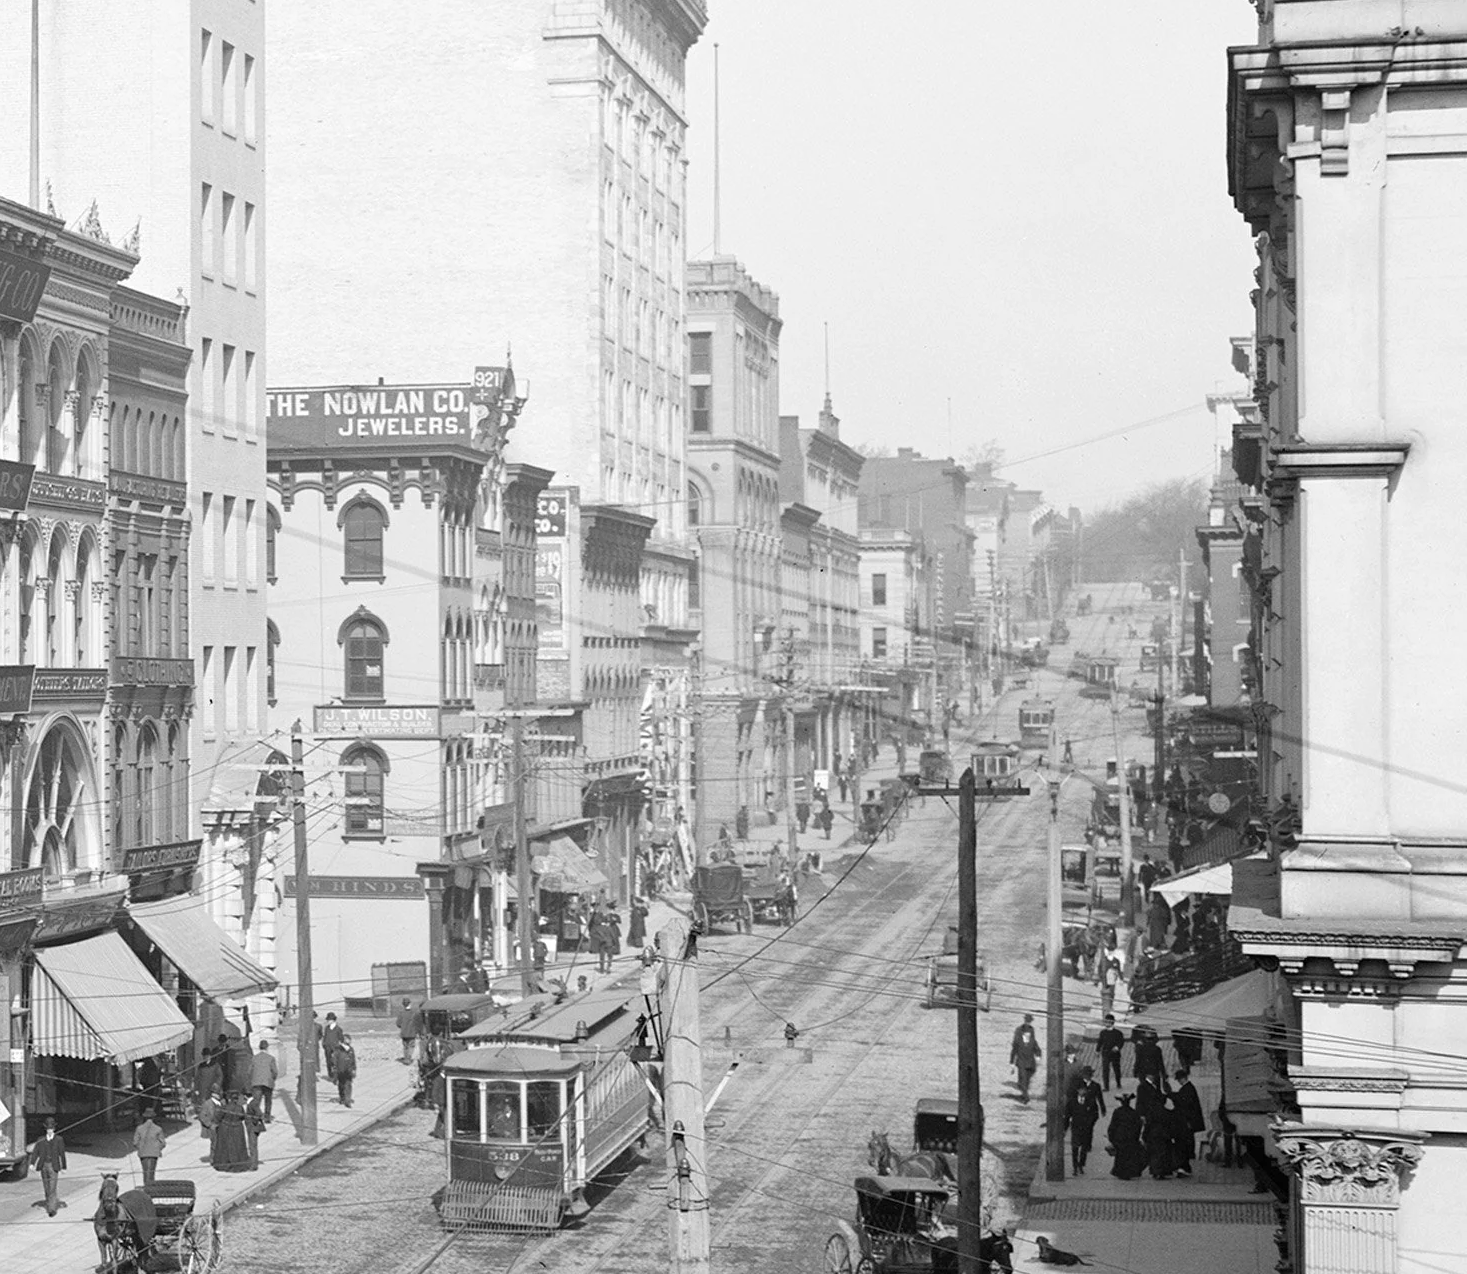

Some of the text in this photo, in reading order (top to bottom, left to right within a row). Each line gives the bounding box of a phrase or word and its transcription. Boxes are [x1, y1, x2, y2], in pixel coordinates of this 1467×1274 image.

[10, 270, 41, 313] CO.
[266, 390, 469, 417] THE NOWLAN CO.
[338, 416, 466, 437] JEWELERS.
